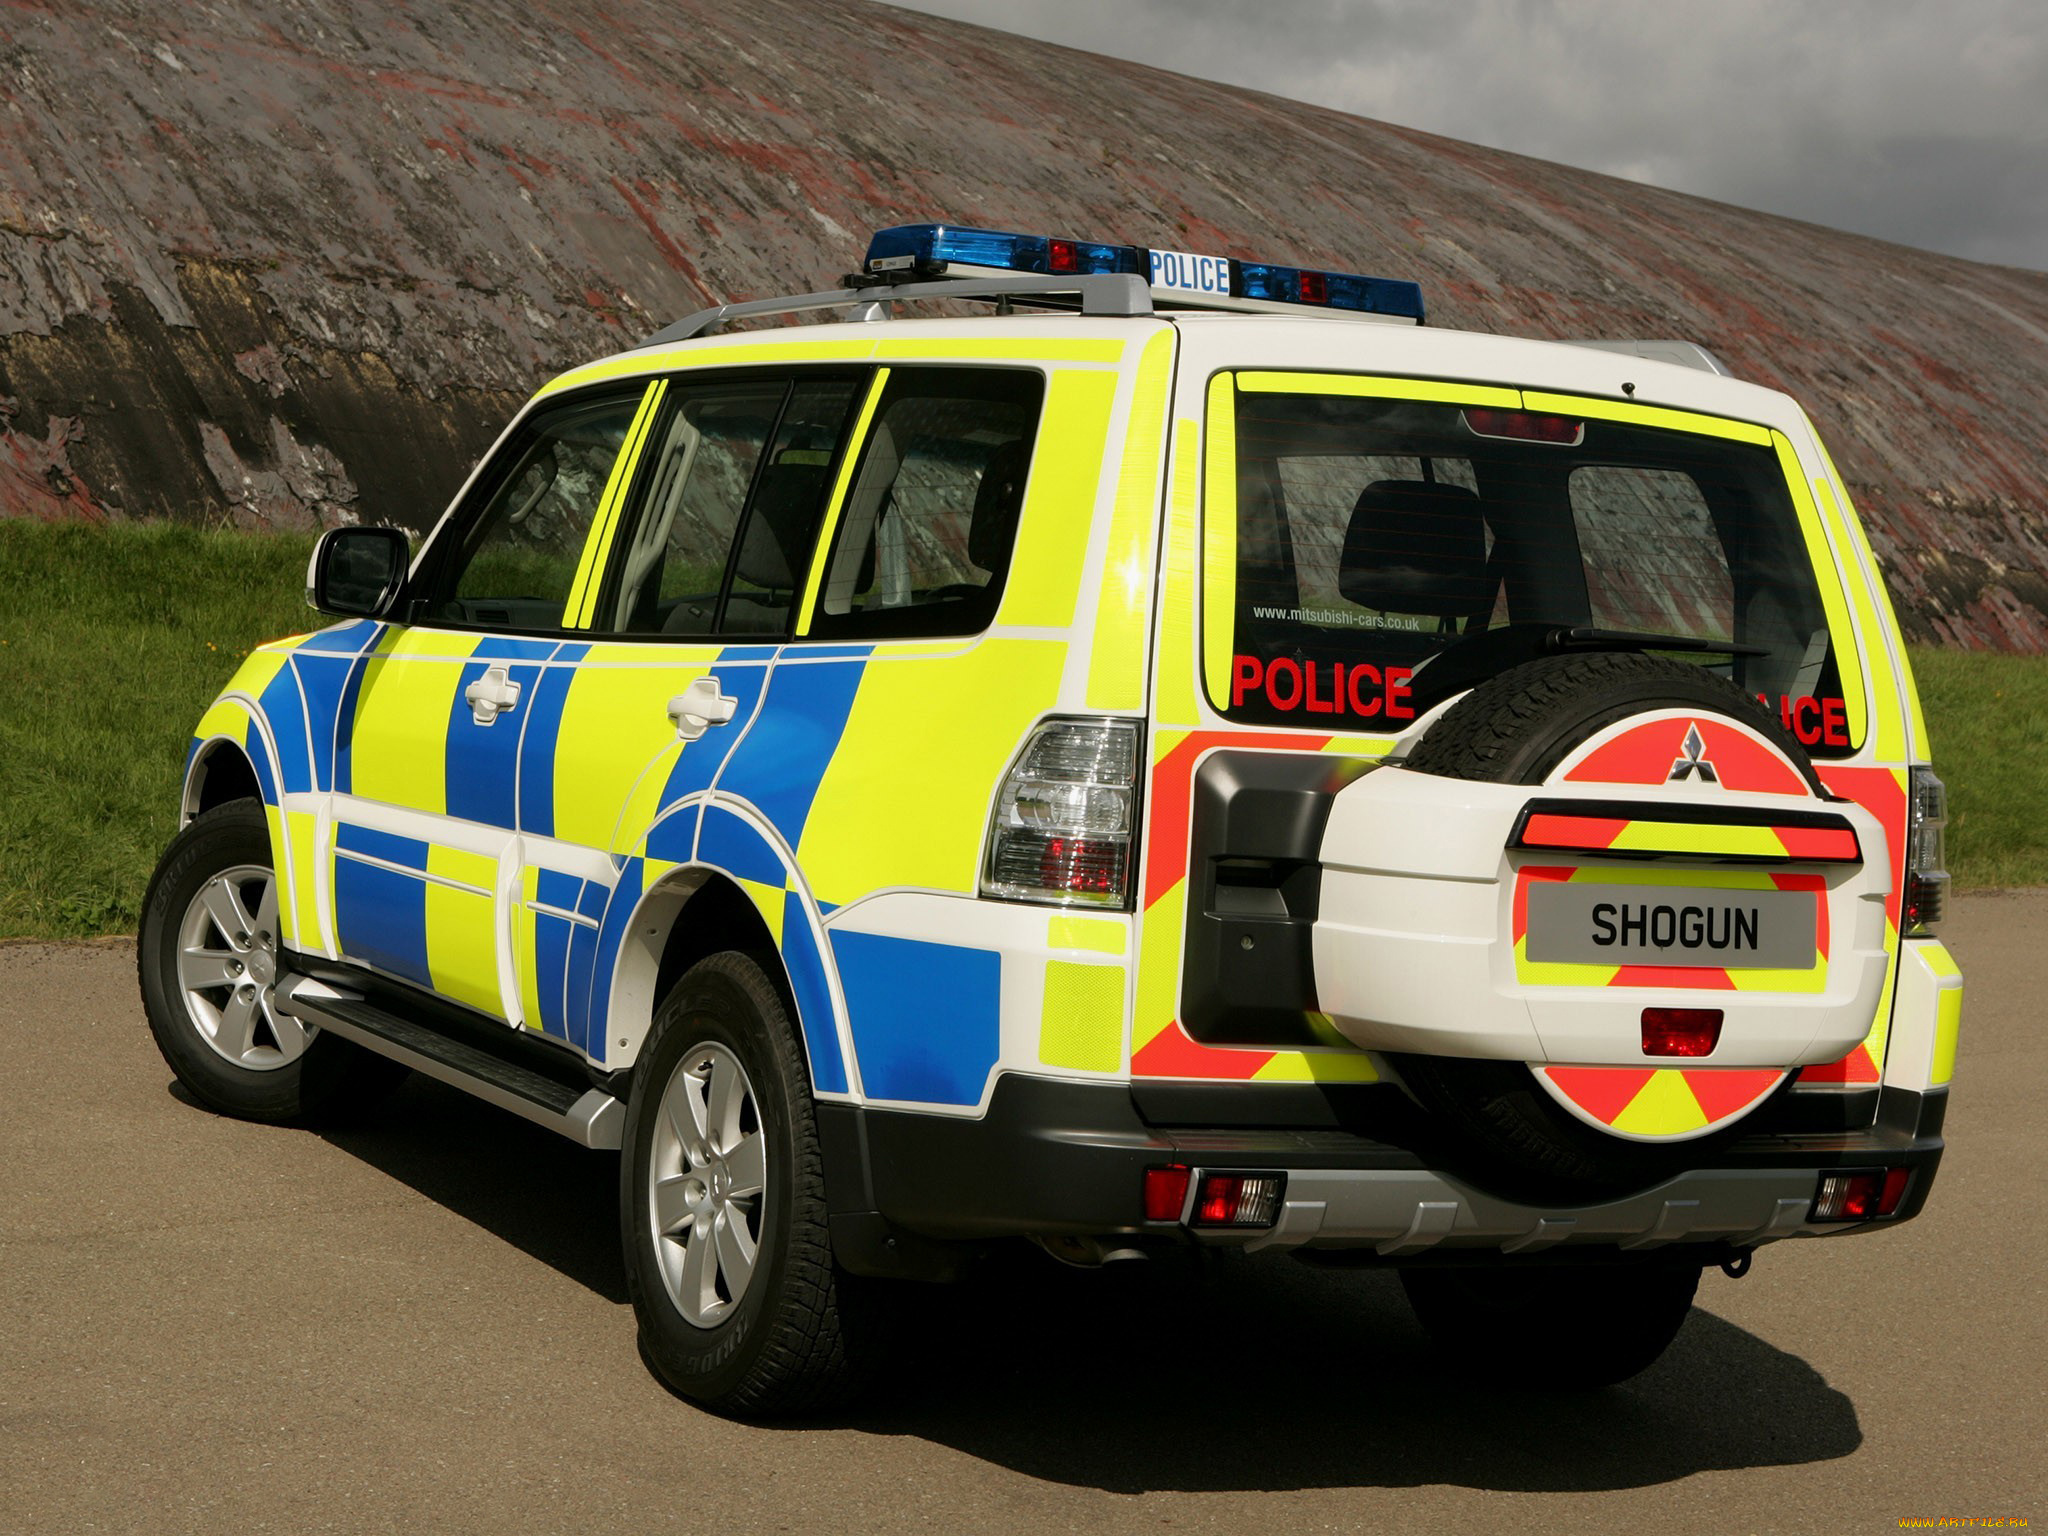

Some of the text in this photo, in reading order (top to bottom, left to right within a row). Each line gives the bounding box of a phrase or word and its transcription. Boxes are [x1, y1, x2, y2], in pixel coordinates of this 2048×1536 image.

[1149, 251, 1229, 293] POLICE
[1253, 606, 1420, 631] www.mitsubishi-cars.co.uk
[1232, 654, 1415, 719] POLICE
[1757, 693, 1848, 746] ICE
[1591, 903, 1759, 950] SHOGUN
